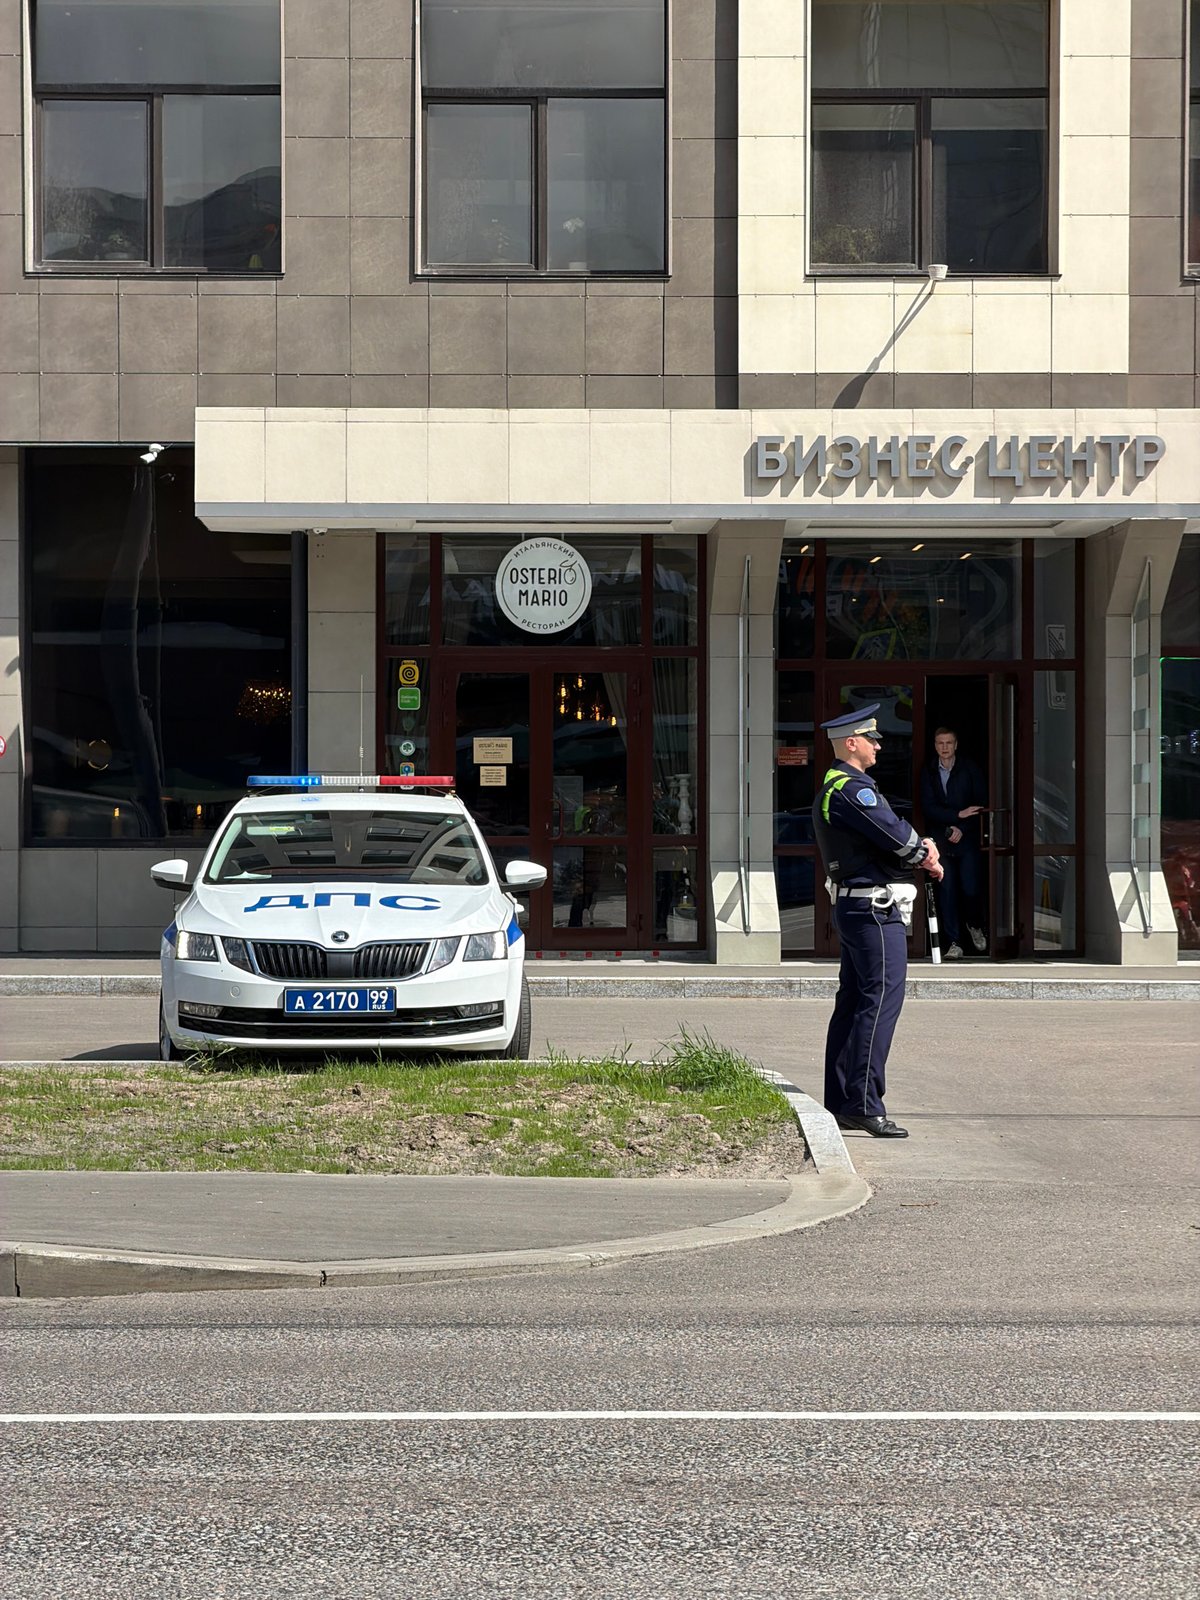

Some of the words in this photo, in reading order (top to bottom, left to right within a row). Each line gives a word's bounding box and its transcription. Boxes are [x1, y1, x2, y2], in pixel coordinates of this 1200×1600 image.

[757, 435, 968, 479] БИЗНЕС
[988, 435, 1166, 487] ЦЕНТР
[514, 542, 575, 558] ИТАЛЬЯНСКИЙ
[518, 589, 568, 606] MARIO
[521, 618, 565, 630] РЕСТОРАН
[243, 892, 442, 913] ДПС
[312, 991, 359, 1010] 2170
[370, 990, 389, 1004] 99
